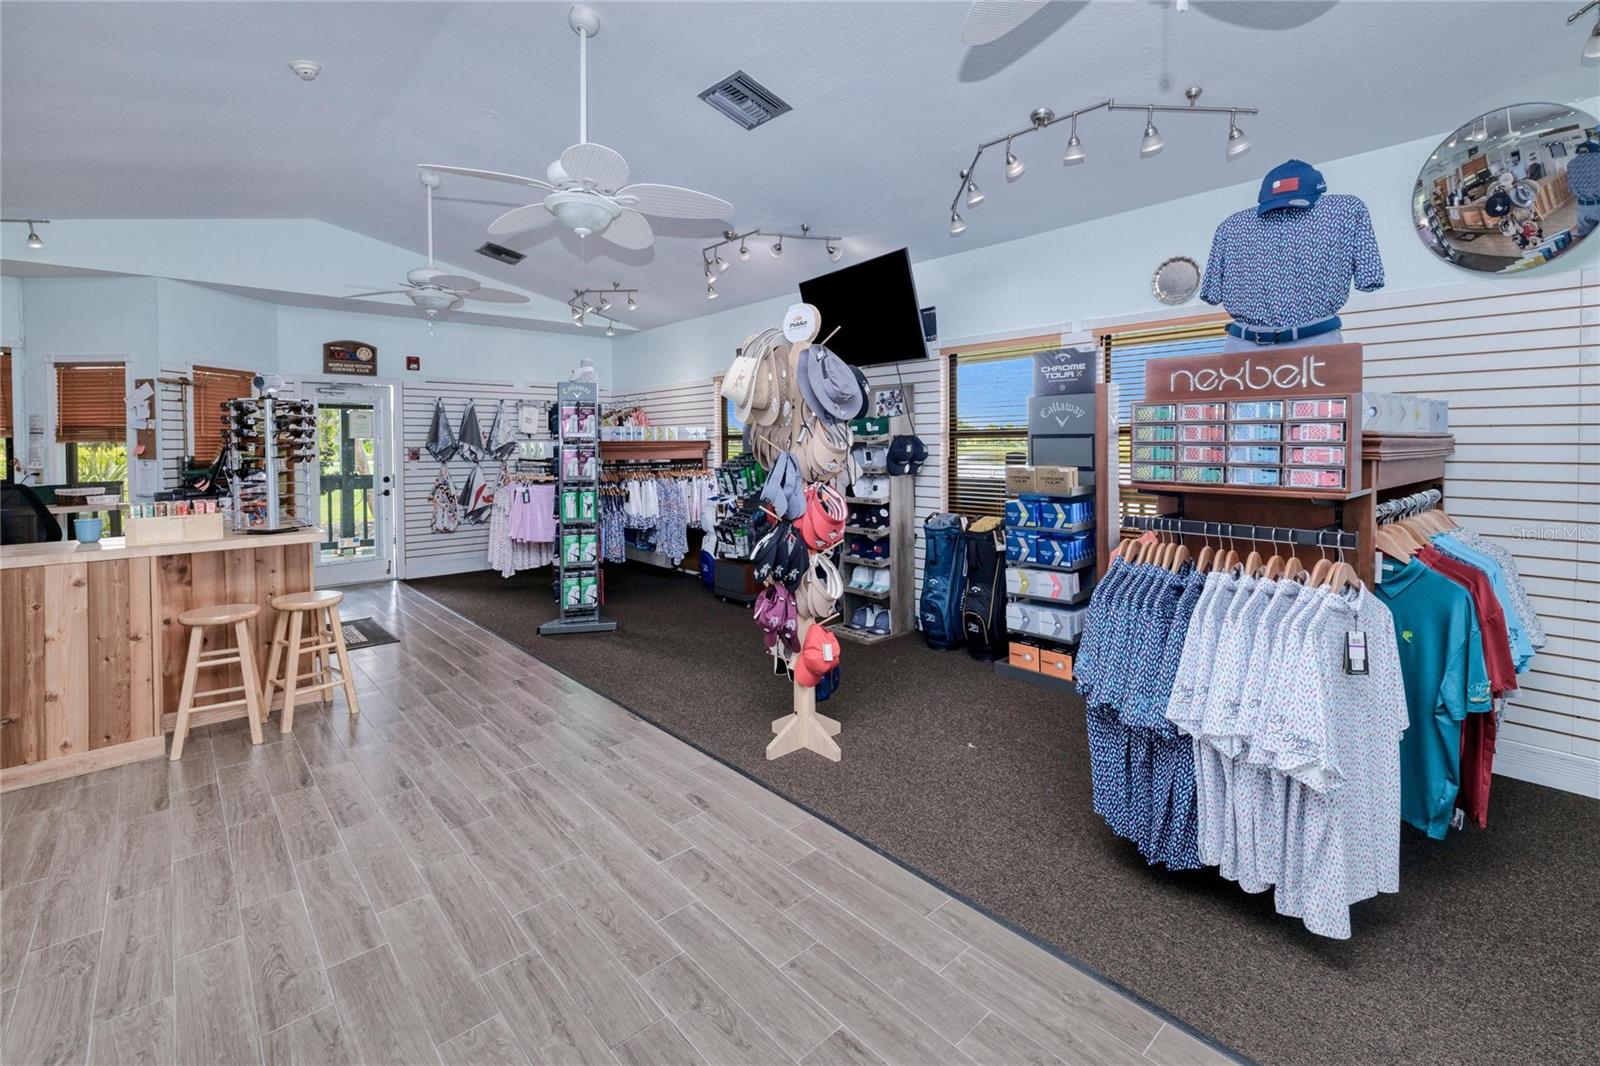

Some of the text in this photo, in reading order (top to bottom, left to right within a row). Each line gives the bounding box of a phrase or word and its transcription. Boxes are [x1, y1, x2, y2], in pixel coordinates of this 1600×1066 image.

[1040, 363, 1086, 373] CHROME
[1044, 371, 1074, 379] TOUR
[1170, 354, 1326, 392] nexbelt
[1040, 400, 1086, 418] Callaway
